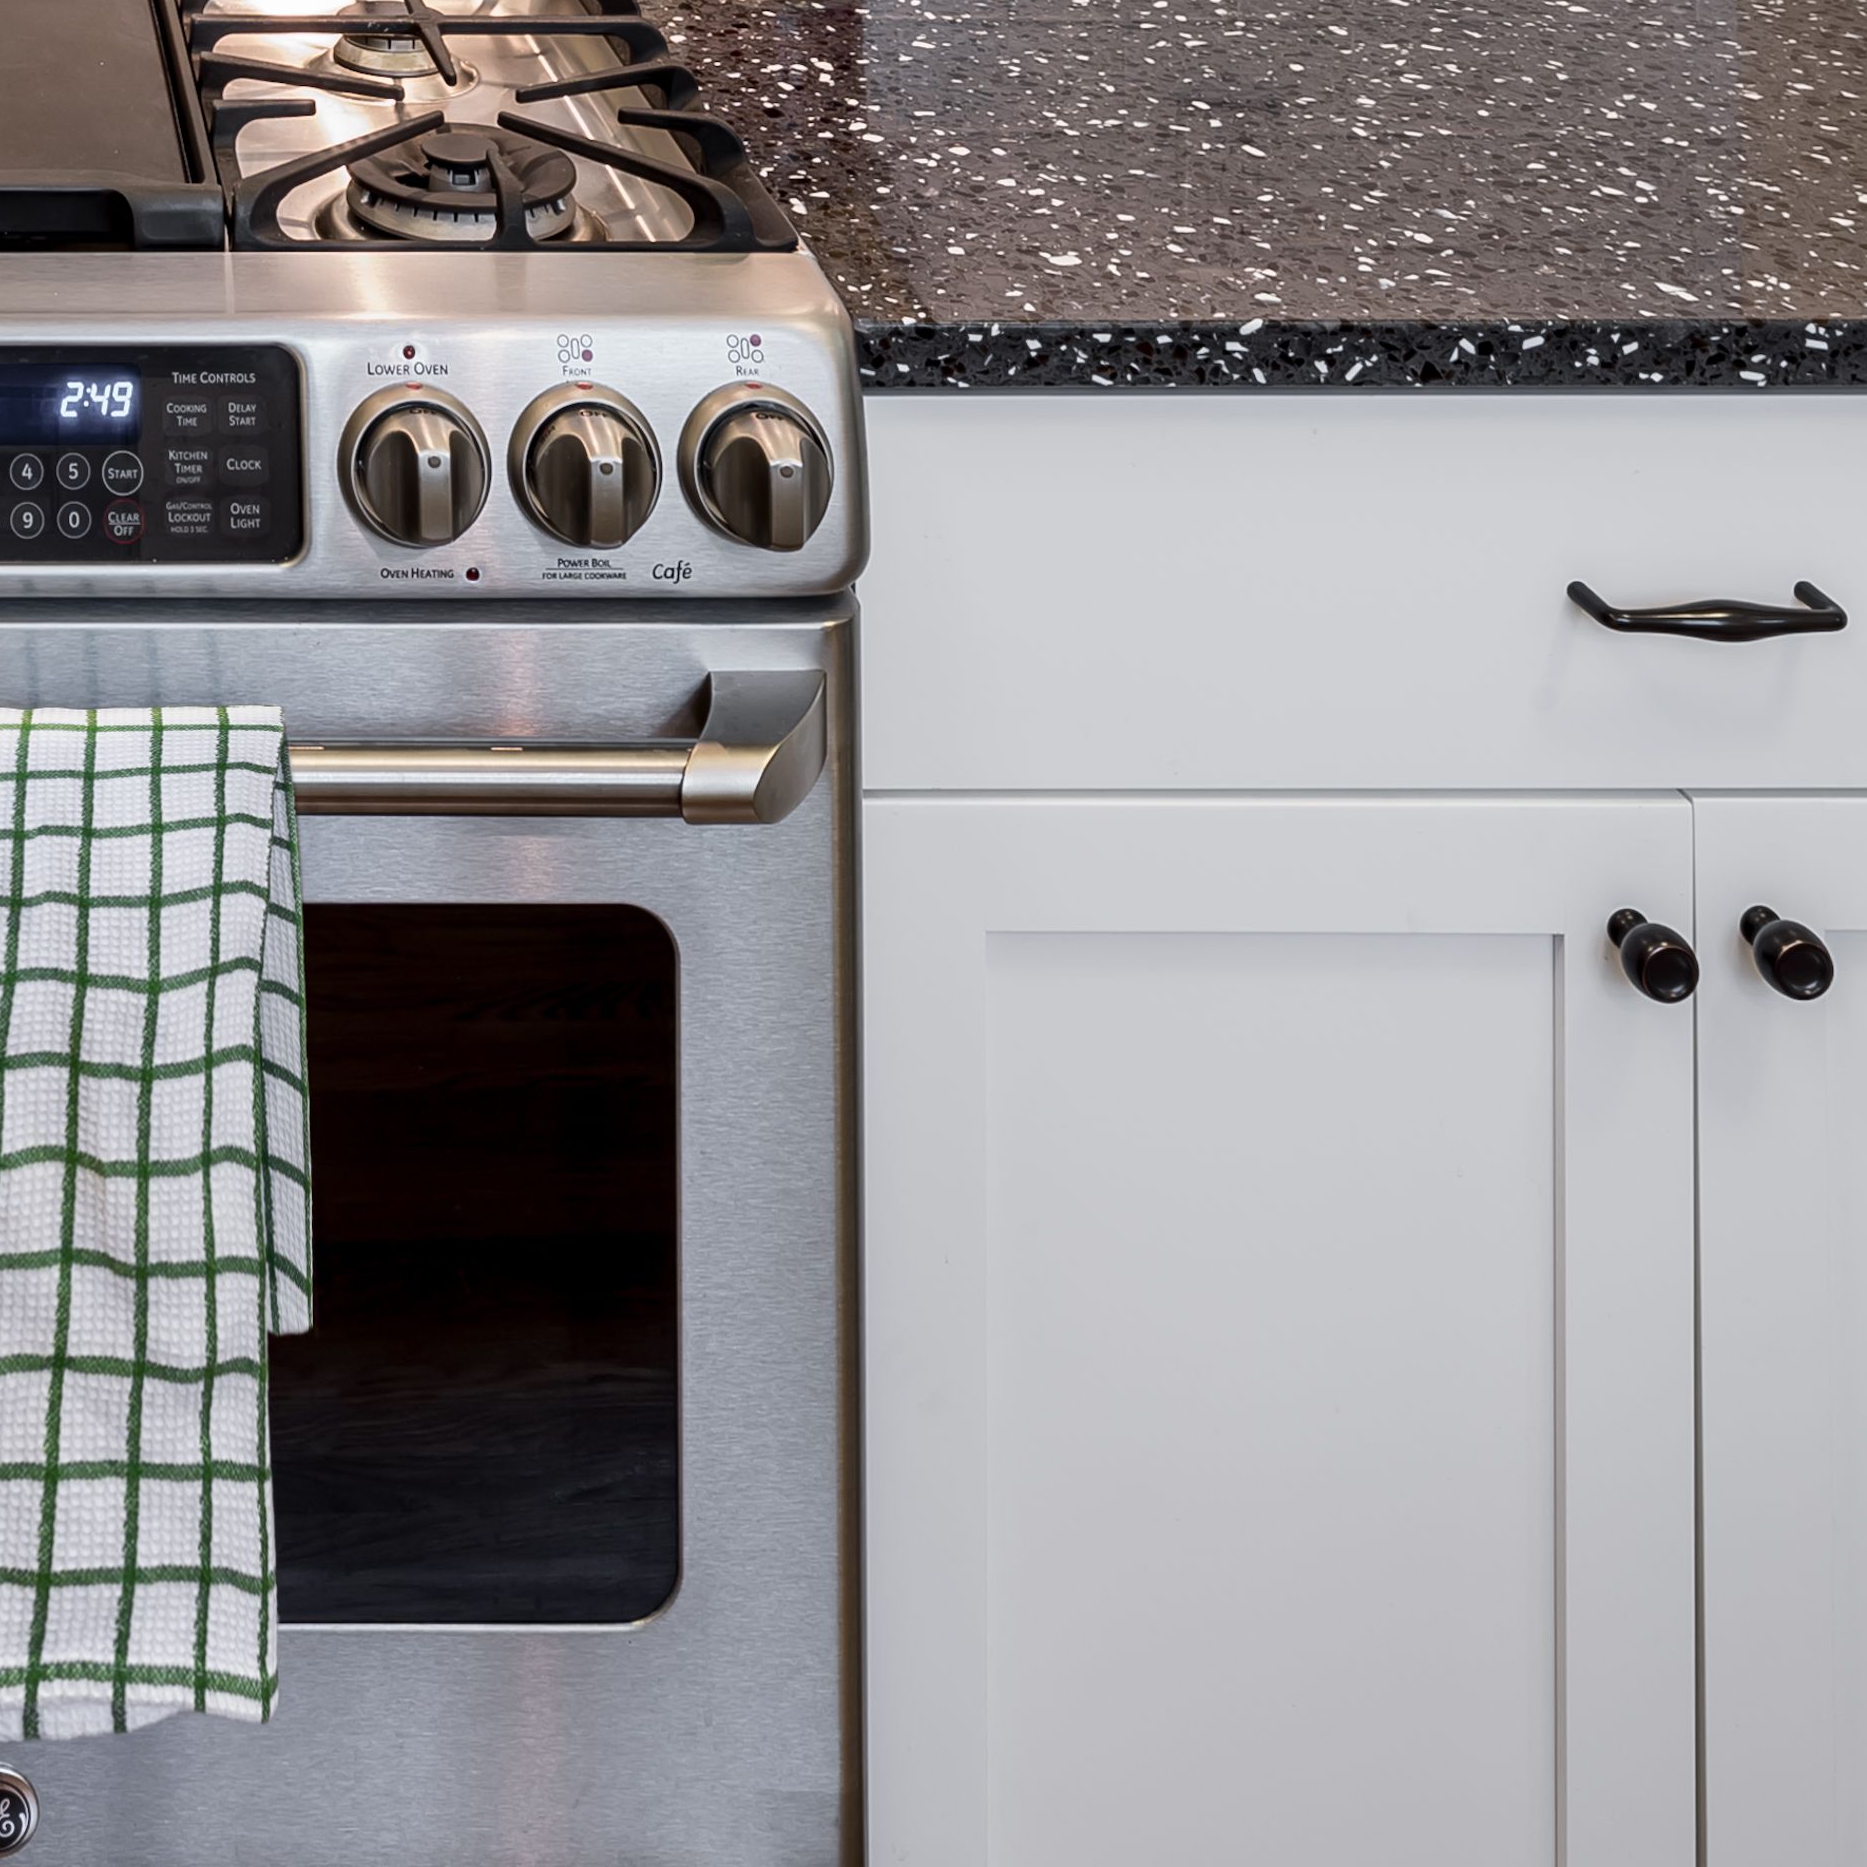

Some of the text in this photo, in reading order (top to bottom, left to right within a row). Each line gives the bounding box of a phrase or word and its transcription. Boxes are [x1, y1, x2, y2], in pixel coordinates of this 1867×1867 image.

[367, 362, 449, 376] LOWER OVEN
[562, 366, 592, 377] FRONT
[735, 366, 759, 377] REAR
[171, 371, 257, 384] TIME CONTROLS
[60, 381, 133, 417] 2:49
[166, 403, 207, 414] COOKING
[227, 403, 257, 414] DELAY
[175, 415, 197, 427] TIME
[229, 415, 257, 427] START
[167, 450, 208, 461] KITCHEN
[68, 463, 79, 479] 5
[173, 463, 203, 475] TIMER
[226, 459, 261, 471] CLOCK
[21, 463, 33, 480] 4
[107, 468, 138, 479] START
[165, 501, 213, 511] GAS/CONTROL
[229, 503, 261, 515] OVEN
[22, 512, 33, 529] 9
[69, 511, 80, 528] 0
[107, 511, 140, 523] CLEAR
[168, 511, 211, 523] LOCKOUT
[229, 517, 261, 529] LIGHT
[113, 524, 134, 537] OFF
[557, 558, 611, 568] POWER BOIL
[379, 567, 454, 579] OVEN HEATING
[542, 571, 627, 580] FOR LARGE COOKWARE
[653, 561, 693, 584] Café
